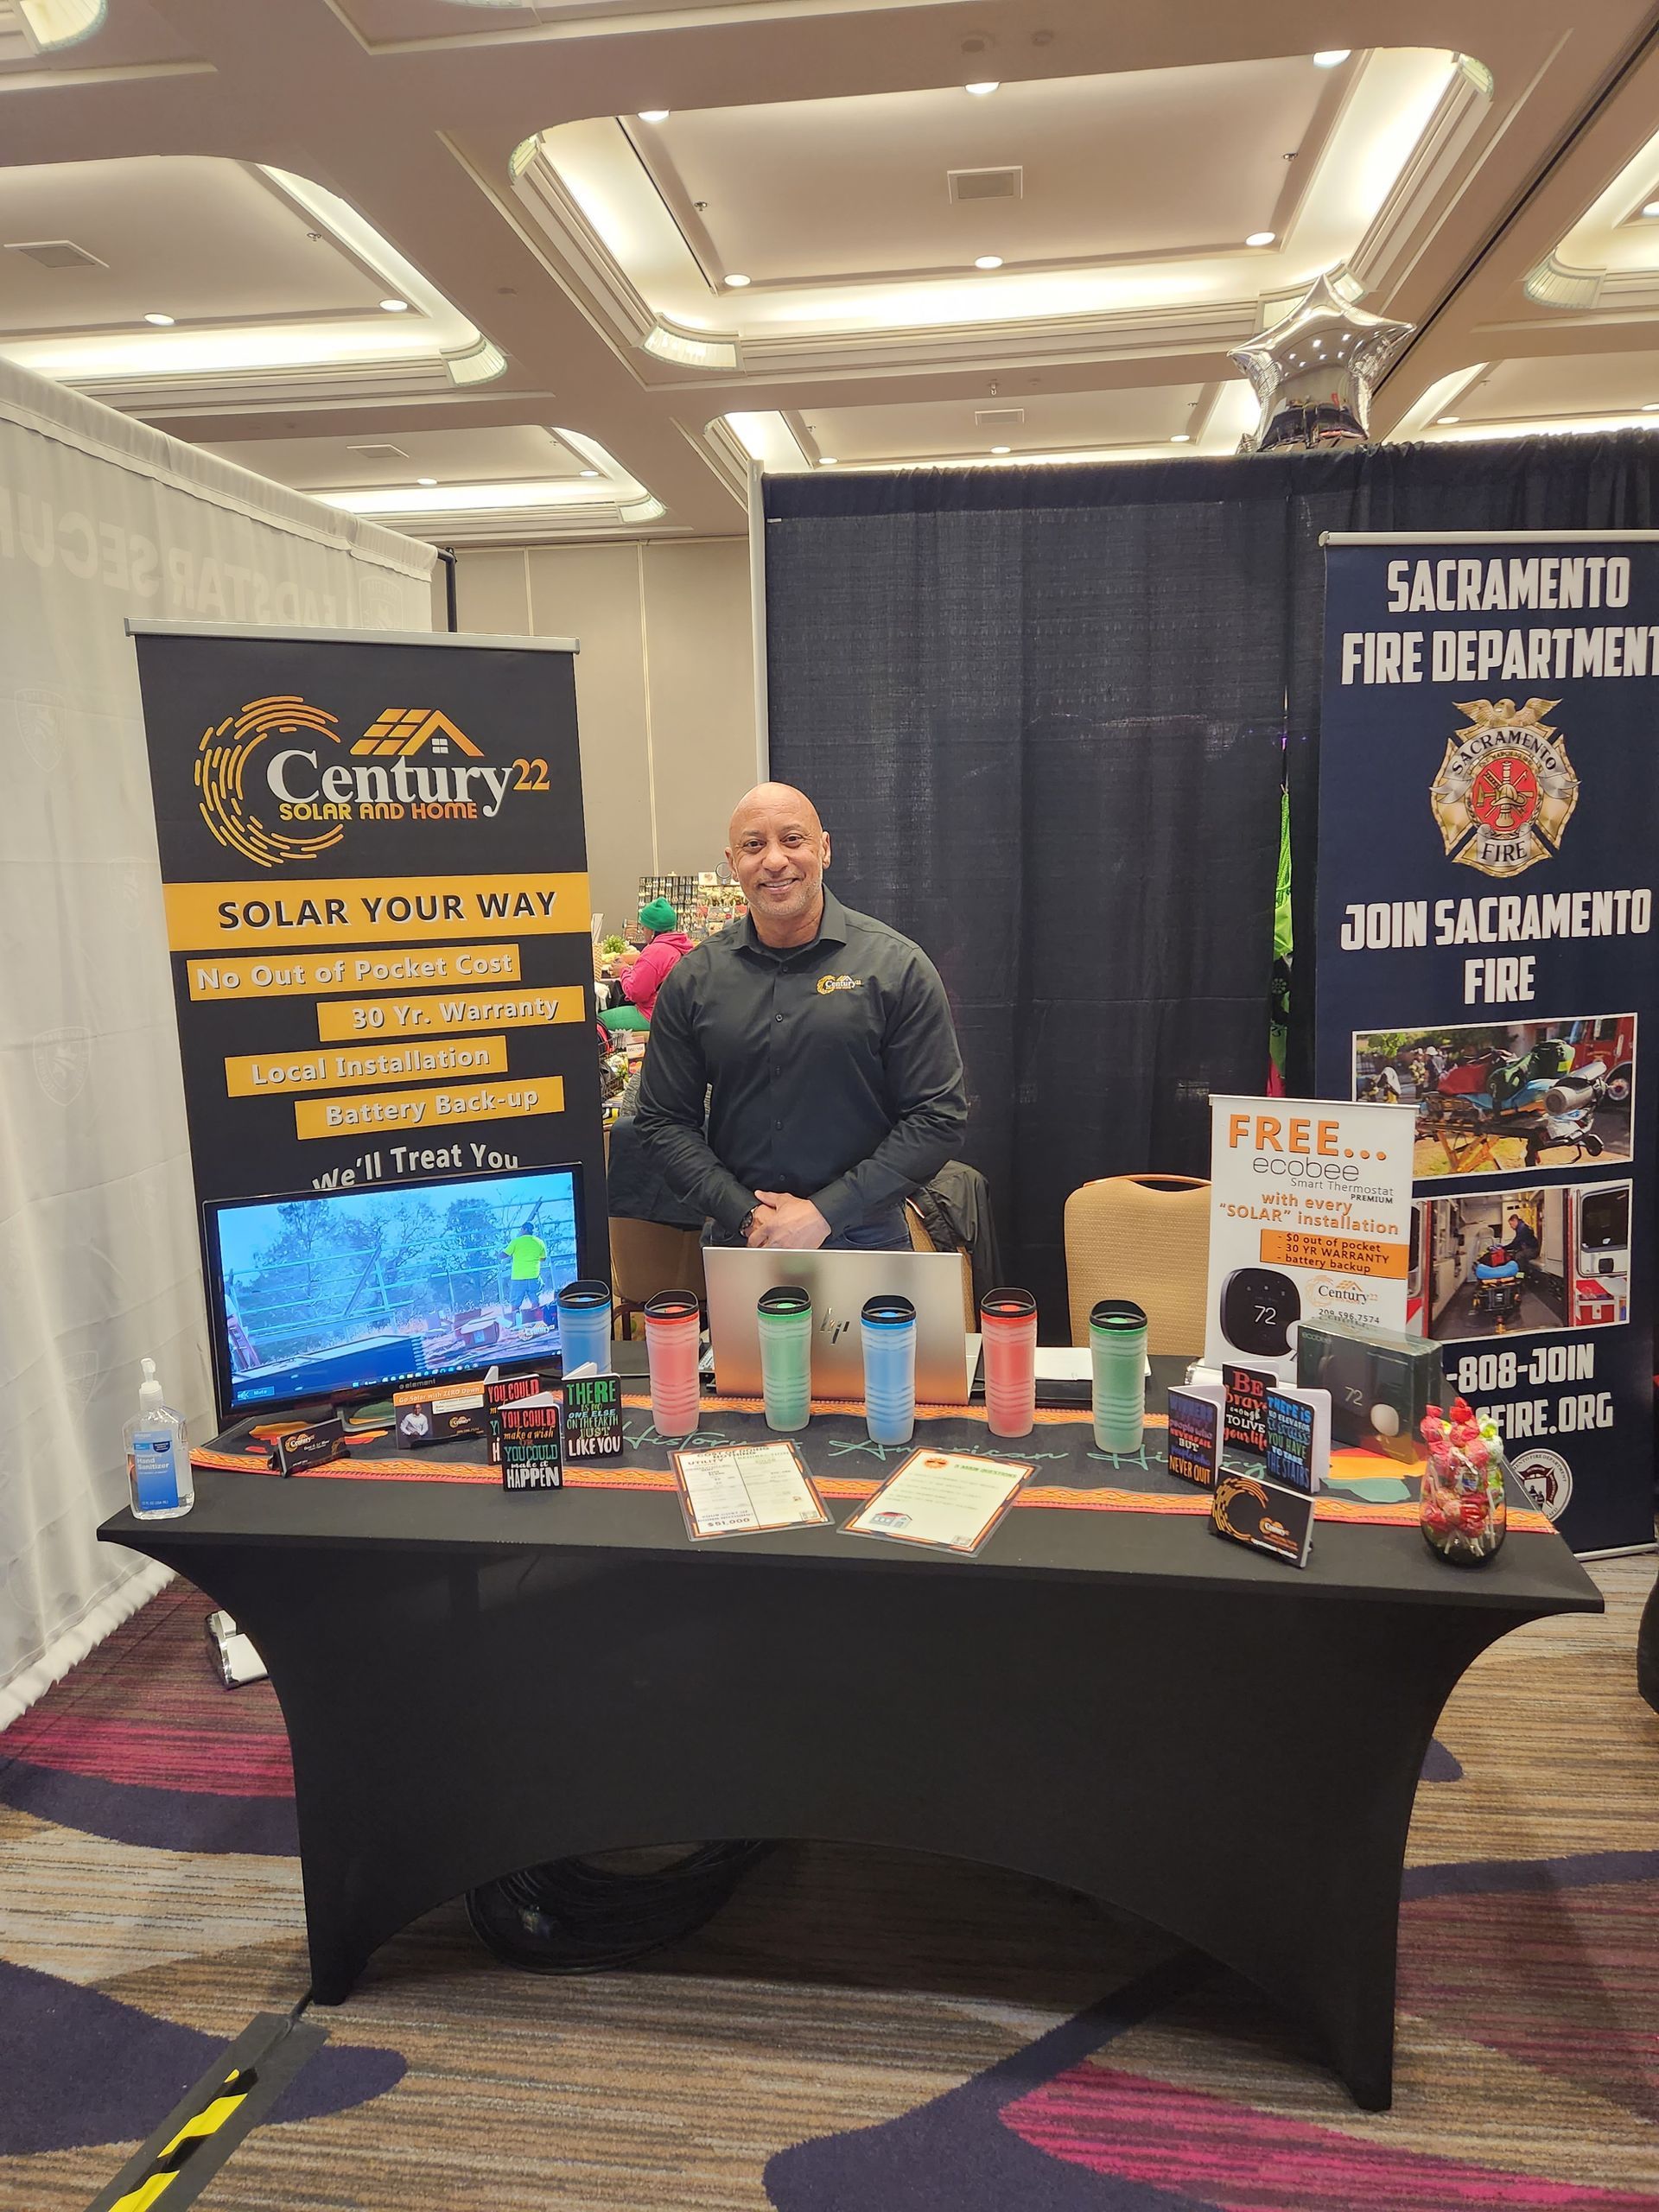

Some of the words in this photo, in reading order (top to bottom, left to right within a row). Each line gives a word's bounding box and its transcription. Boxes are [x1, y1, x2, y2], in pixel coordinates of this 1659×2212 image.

[1387, 556, 1630, 613] SACRAMENTO
[1341, 631, 1425, 685] FIRE
[1452, 730, 1556, 775] SACRAMENTO
[266, 749, 512, 817] Century
[512, 758, 550, 791] 22
[279, 803, 353, 821] SOLAR
[359, 803, 404, 820] AND
[412, 803, 478, 819] HOME
[1481, 841, 1528, 862] FIRE
[218, 898, 351, 931] SOLAR
[360, 894, 467, 925] YOUR
[476, 891, 557, 919] WAY
[1340, 900, 1428, 951] JOIN
[1433, 888, 1652, 945] SACRAMENTO
[197, 968, 241, 990] No
[251, 963, 306, 987] Out
[315, 961, 345, 983] of
[355, 957, 448, 982] Pocket
[455, 953, 513, 975] Cost
[1465, 956, 1535, 1004] FIRE
[825, 980, 855, 989] Century
[352, 1007, 385, 1030] 30
[394, 1005, 432, 1027] Yr.
[440, 997, 560, 1024] Warranty
[251, 1058, 326, 1085] Local
[336, 1046, 491, 1077] Installation
[326, 1101, 426, 1128] Battery
[435, 1089, 540, 1116] Back-up
[1229, 1113, 1387, 1160] FREE...
[311, 1151, 382, 1190] We'll
[390, 1144, 463, 1173] Treat
[469, 1142, 518, 1169] You
[1253, 1157, 1358, 1182] ecobee
[1291, 1178, 1323, 1189] Smart
[1327, 1181, 1394, 1197] Thermostat
[1351, 1193, 1394, 1204] PREMIUM
[1262, 1192, 1299, 1207] with
[1305, 1198, 1353, 1216] every
[1298, 1211, 1399, 1235] installation
[1286, 1233, 1300, 1243] $0
[1303, 1236, 1322, 1246] out
[1326, 1237, 1338, 1247] of
[1342, 1240, 1382, 1254] pocket
[1286, 1243, 1299, 1253] 30
[1303, 1245, 1317, 1255] YR
[1321, 1248, 1389, 1264] WARRANTY
[1285, 1255, 1326, 1269] battery
[1330, 1259, 1371, 1274] backup
[1319, 1285, 1367, 1306] Century
[1254, 1305, 1277, 1325] 72
[1319, 1308, 1380, 1324] 209596.7574
[1446, 1343, 1594, 1393] -808-JOIN
[404, 1378, 436, 1389] element
[428, 1391, 442, 1400] with
[443, 1388, 461, 1397] ZERO
[488, 1384, 506, 1403] YOU
[508, 1379, 540, 1401] COULD
[566, 1380, 617, 1406] THERE
[1233, 1370, 1264, 1396] BE
[1344, 1386, 1363, 1407] 72
[502, 1410, 520, 1428] YOU
[523, 1408, 556, 1427] COULD
[567, 1418, 578, 1430] ON
[580, 1417, 594, 1429] THE
[594, 1414, 619, 1427] EARTH
[1226, 1414, 1241, 1427] TO
[1242, 1418, 1266, 1433] LIVE
[534, 1425, 556, 1439] wish
[505, 1446, 525, 1462] YOU
[526, 1444, 558, 1462] COULD
[568, 1438, 596, 1457] LIKE
[596, 1435, 620, 1453] YOU
[1179, 1437, 1199, 1452] BUT
[1268, 1431, 1284, 1448] YOU
[1286, 1439, 1306, 1459] HAVE
[506, 1466, 560, 1489] HAPPEN
[1169, 1455, 1192, 1478] NEVER
[1193, 1464, 1211, 1484] QUIT
